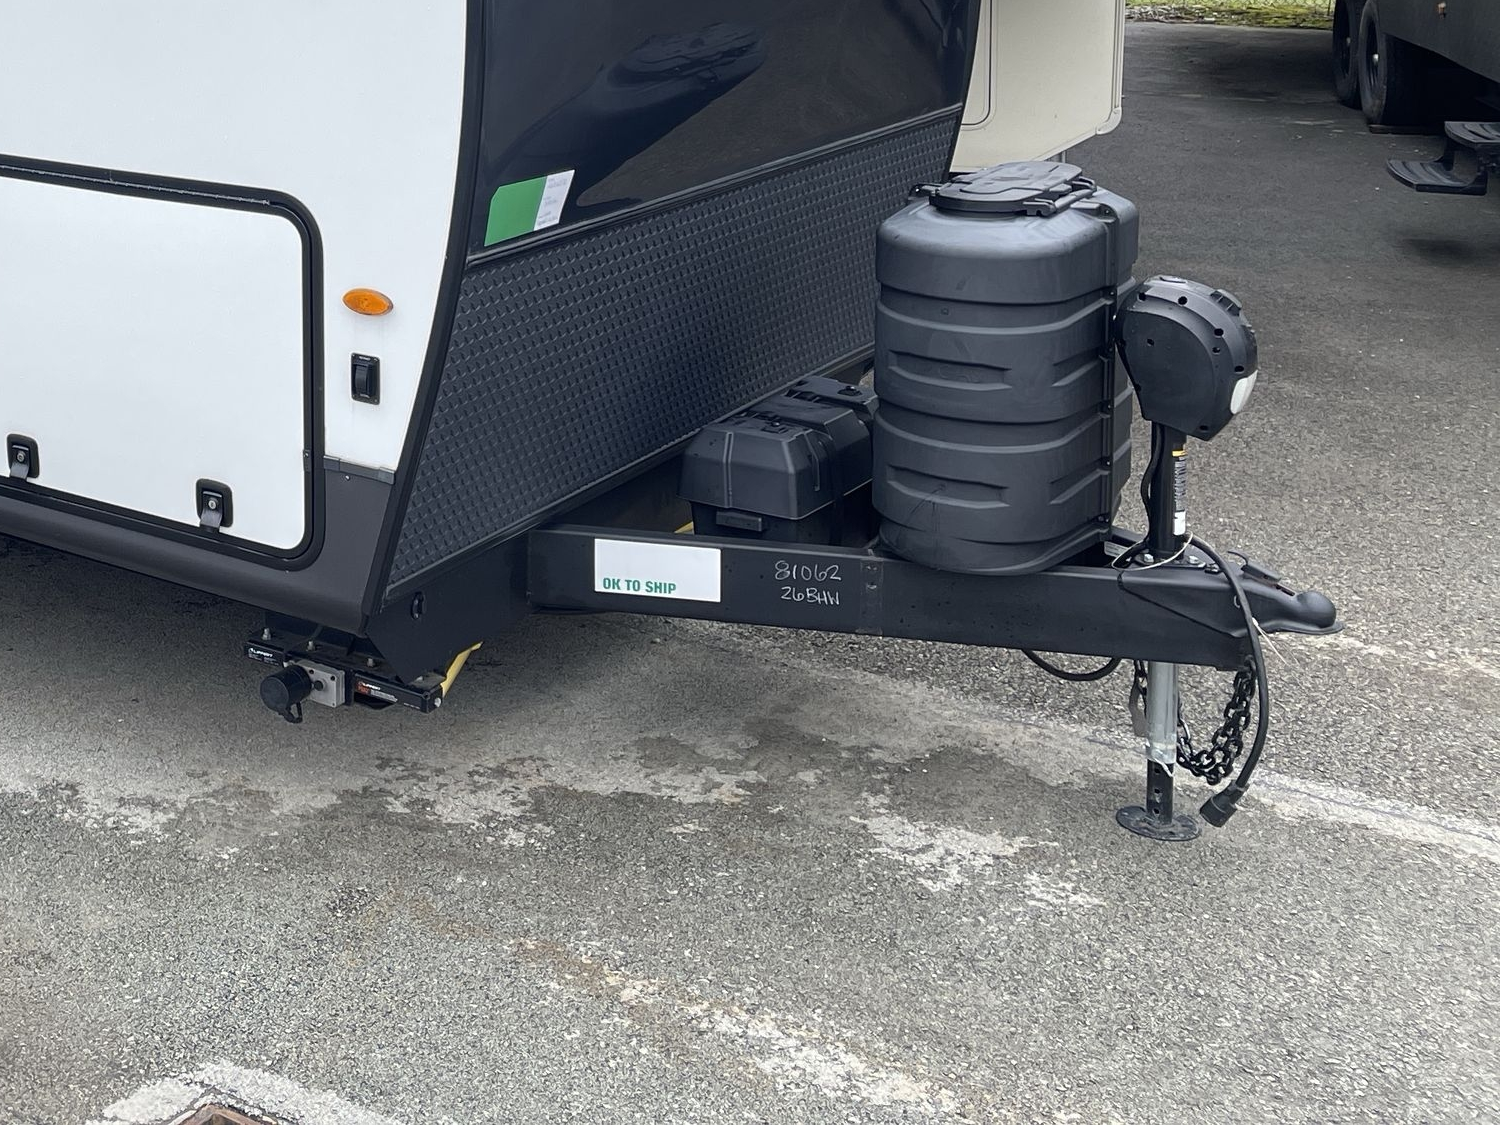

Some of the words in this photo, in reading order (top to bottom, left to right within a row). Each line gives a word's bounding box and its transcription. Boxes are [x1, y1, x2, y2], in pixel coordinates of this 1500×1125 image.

[774, 560, 843, 581] 81062
[602, 577, 621, 591] OK
[625, 579, 641, 593] TO
[645, 580, 677, 595] SHIP
